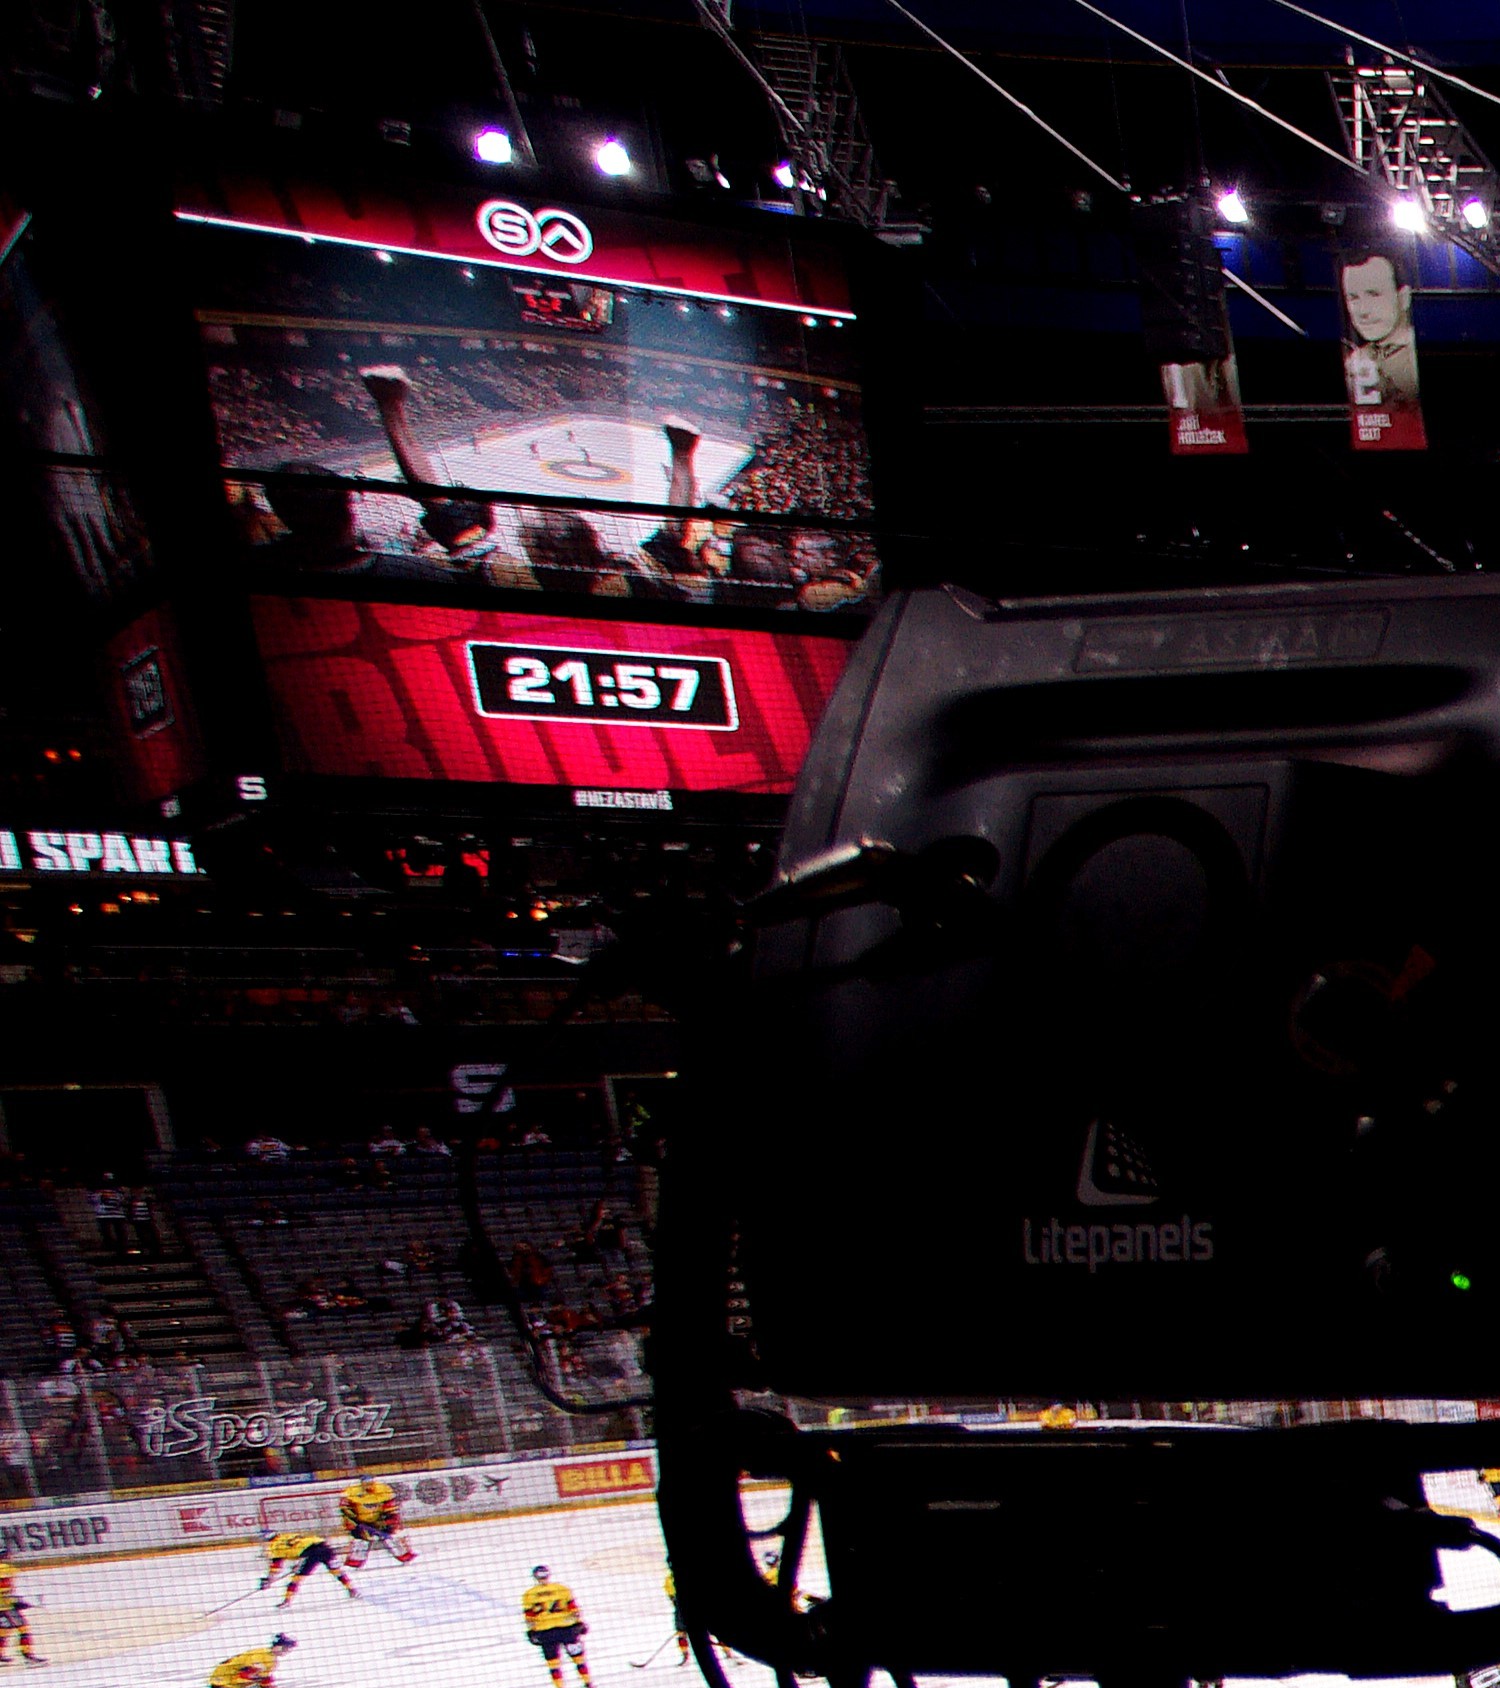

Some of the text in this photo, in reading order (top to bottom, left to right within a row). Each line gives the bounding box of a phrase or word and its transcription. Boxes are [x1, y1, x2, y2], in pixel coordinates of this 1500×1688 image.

[506, 656, 701, 712] 21:57
[1023, 1213, 1215, 1275] Litepanels
[562, 1462, 650, 1490] BILLA
